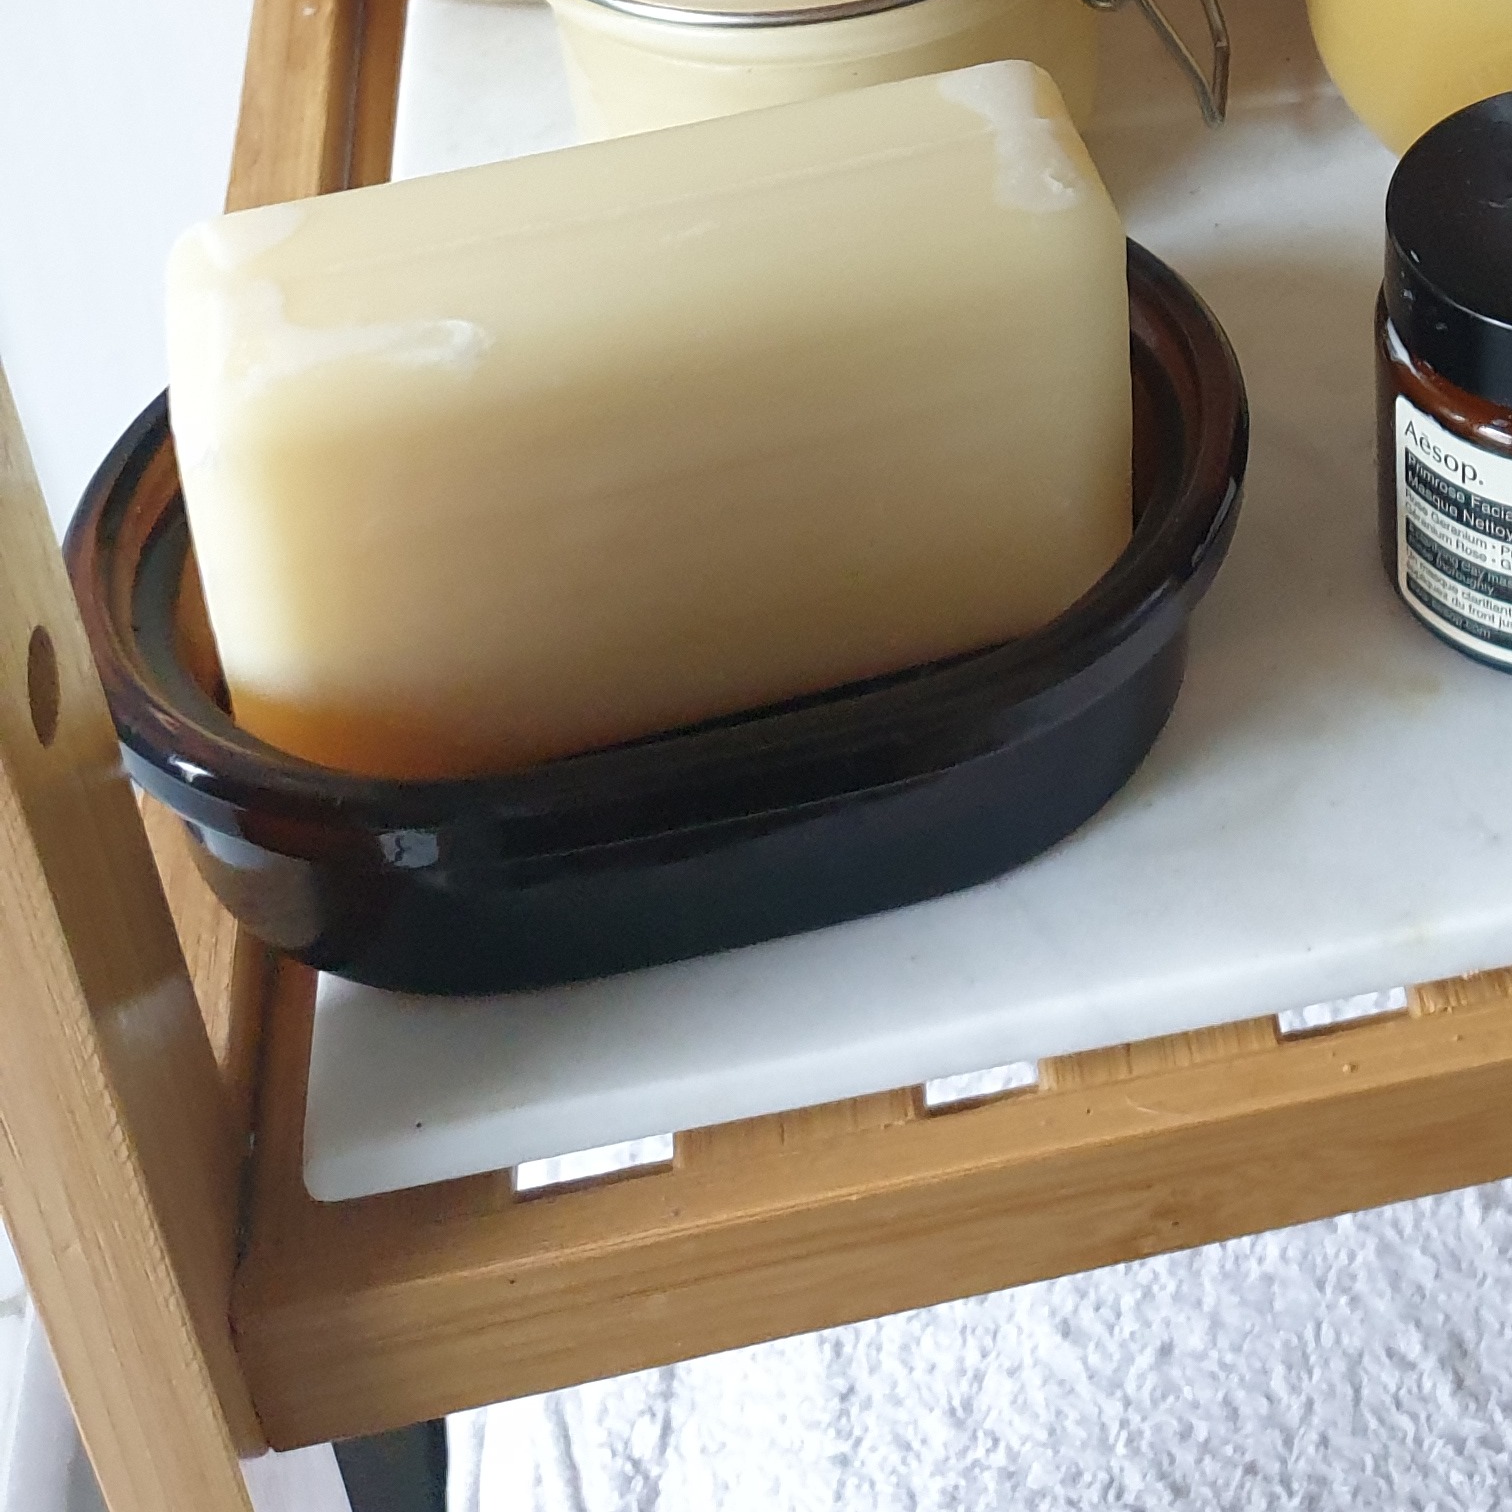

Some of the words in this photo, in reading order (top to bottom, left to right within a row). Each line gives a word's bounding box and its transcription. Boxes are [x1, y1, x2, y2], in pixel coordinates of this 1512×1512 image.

[1407, 452, 1465, 504] Primrose
[1407, 470, 1458, 519] Masque
[1431, 511, 1488, 550] Geranium
[1456, 538, 1488, 563] Rose
